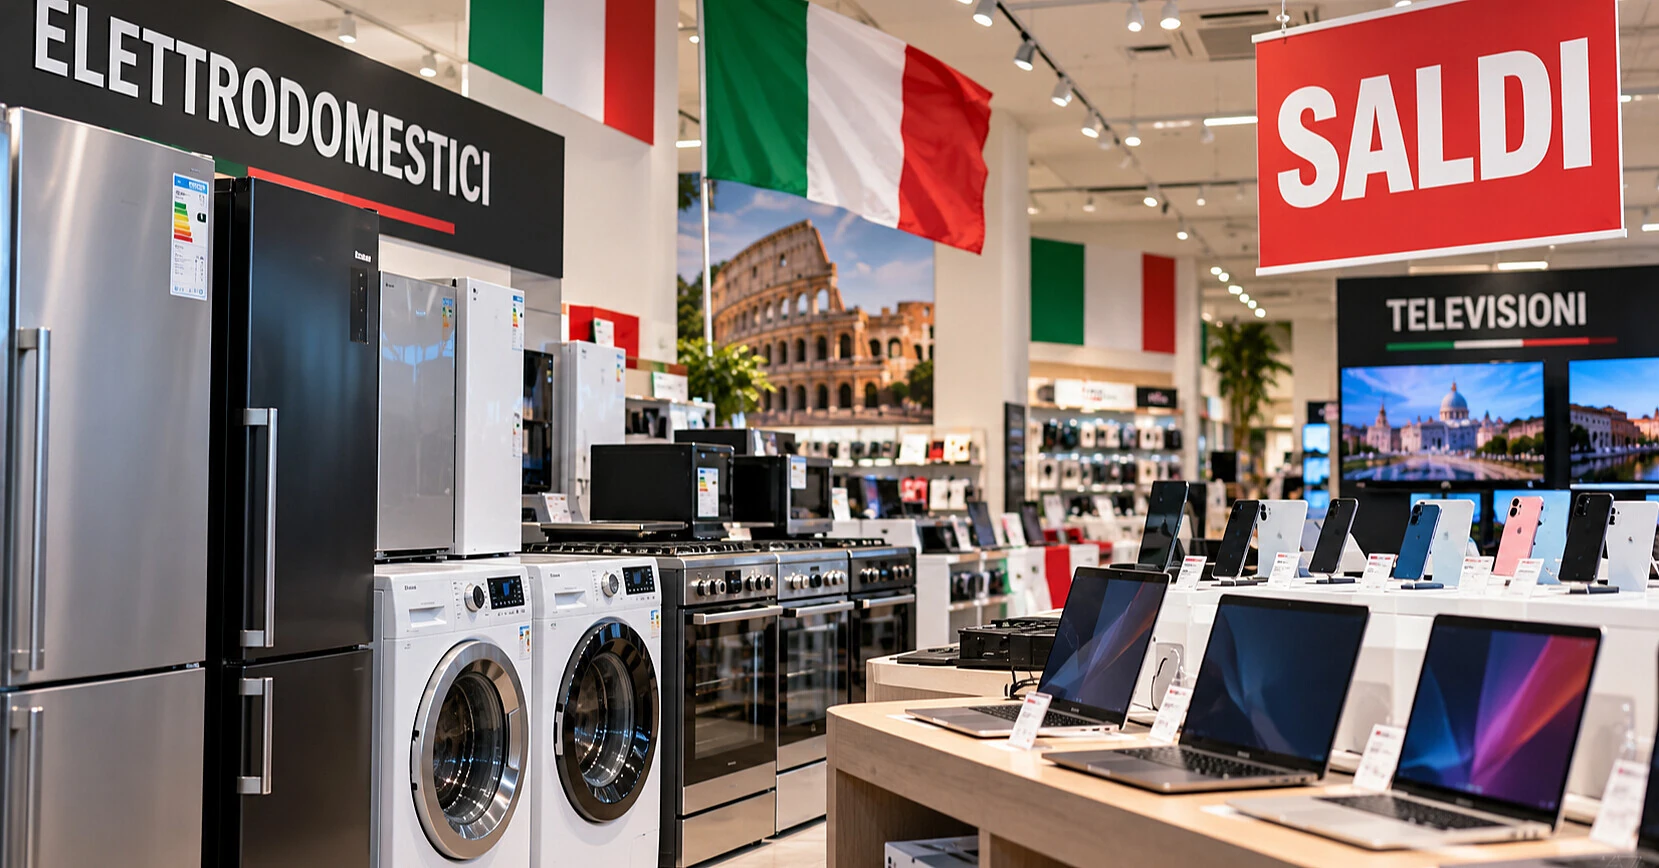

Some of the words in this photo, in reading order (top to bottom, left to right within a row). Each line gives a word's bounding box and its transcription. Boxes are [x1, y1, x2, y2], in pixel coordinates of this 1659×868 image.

[34, 0, 491, 206] ELETTRODOMESTICI
[1277, 37, 1592, 208] SALDI
[1386, 291, 1587, 332] TELEVISIONI
